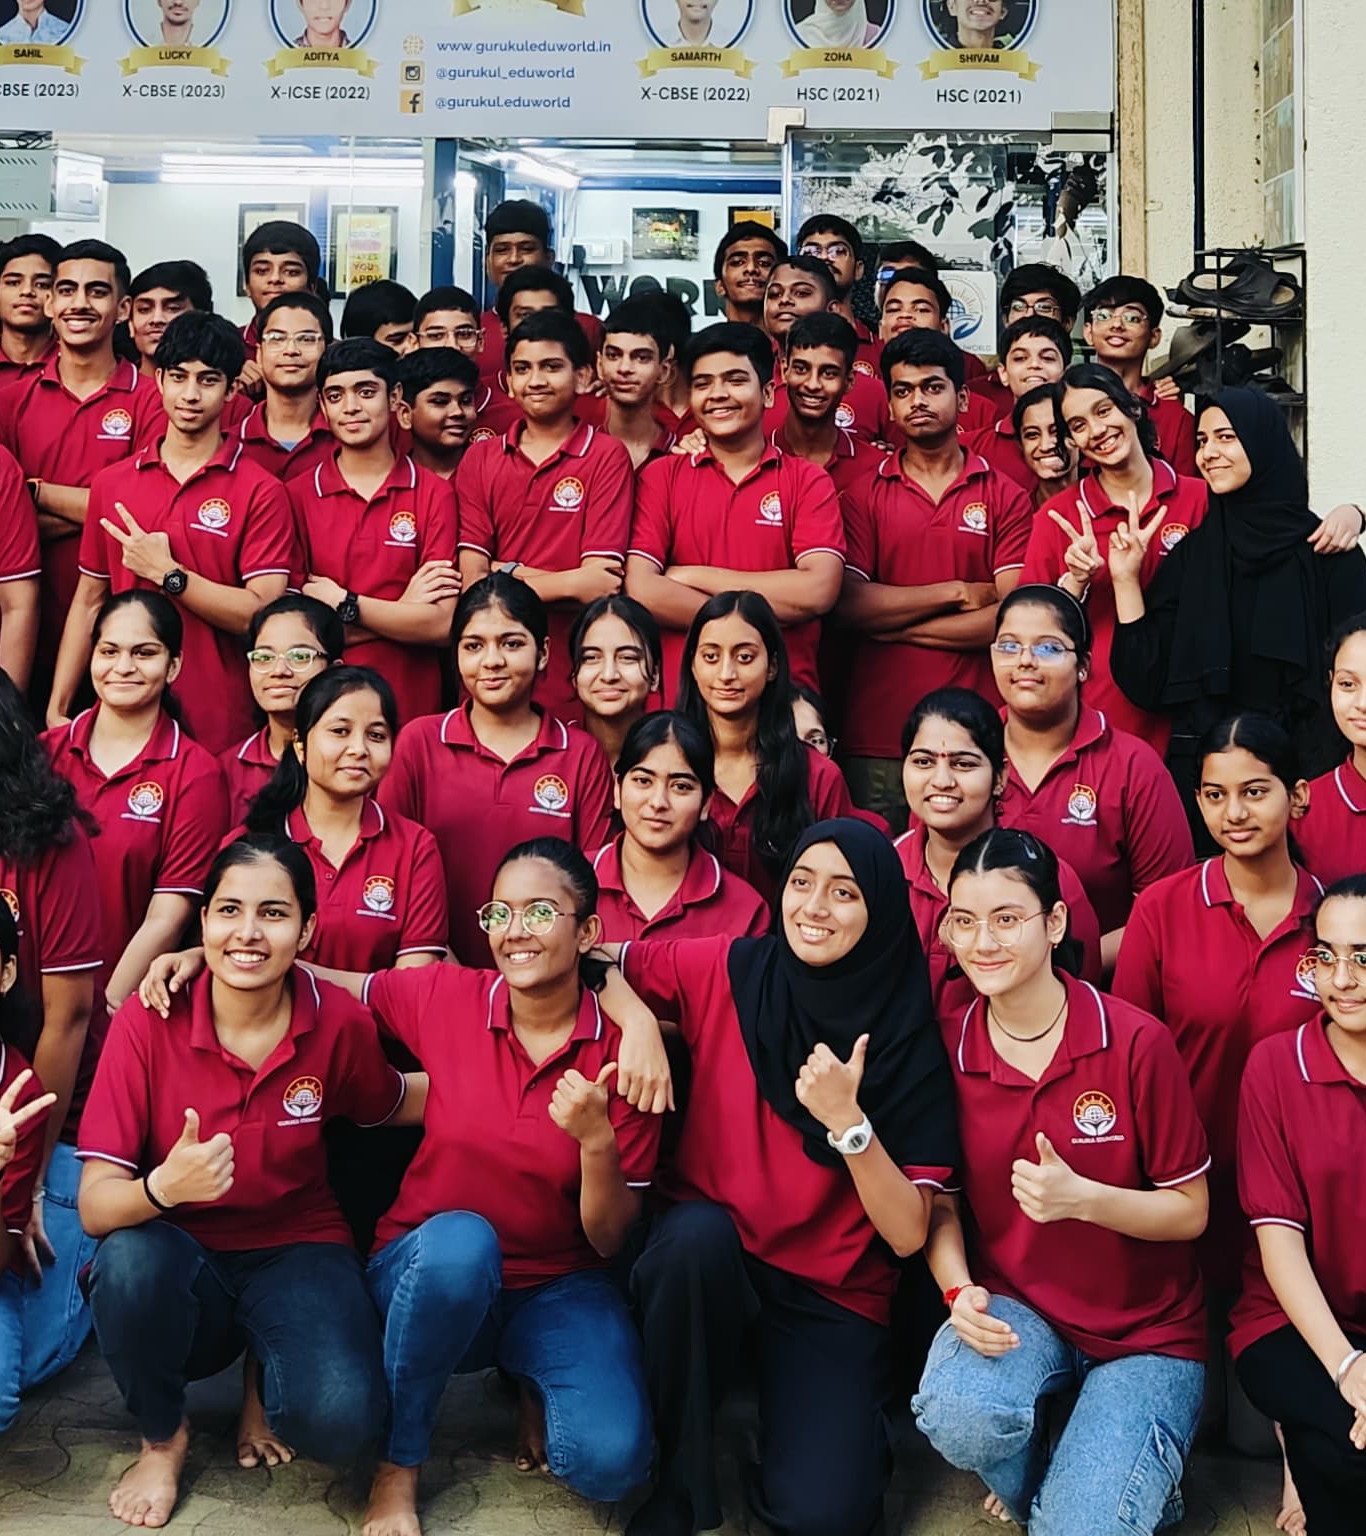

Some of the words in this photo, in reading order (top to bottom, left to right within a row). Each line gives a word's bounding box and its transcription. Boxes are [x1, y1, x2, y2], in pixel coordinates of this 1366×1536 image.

[13, 47, 43, 60] SAHIL
[158, 49, 192, 61] LUCKY
[437, 40, 611, 55] www.gurukuleduworld.in
[303, 50, 340, 63] ADITYA
[670, 51, 722, 63] SAMARTH
[823, 51, 853, 63] ZOHA
[958, 52, 1000, 64] SHIVAM
[436, 66, 575, 81] @gurukul_eduworld
[34, 82, 80, 99] (2023)
[123, 83, 177, 99] X-CBSE
[181, 82, 226, 100] (2023)
[270, 85, 322, 101] X-ICSE
[325, 84, 371, 102] (2022)
[640, 86, 699, 101] X-CBSE
[703, 85, 751, 103] (2022)
[796, 87, 829, 101] HSC
[832, 86, 880, 103] (2021)
[936, 89, 969, 103] HSC
[971, 88, 1022, 104] (2021)
[435, 96, 571, 111] @gurukul.eduworld
